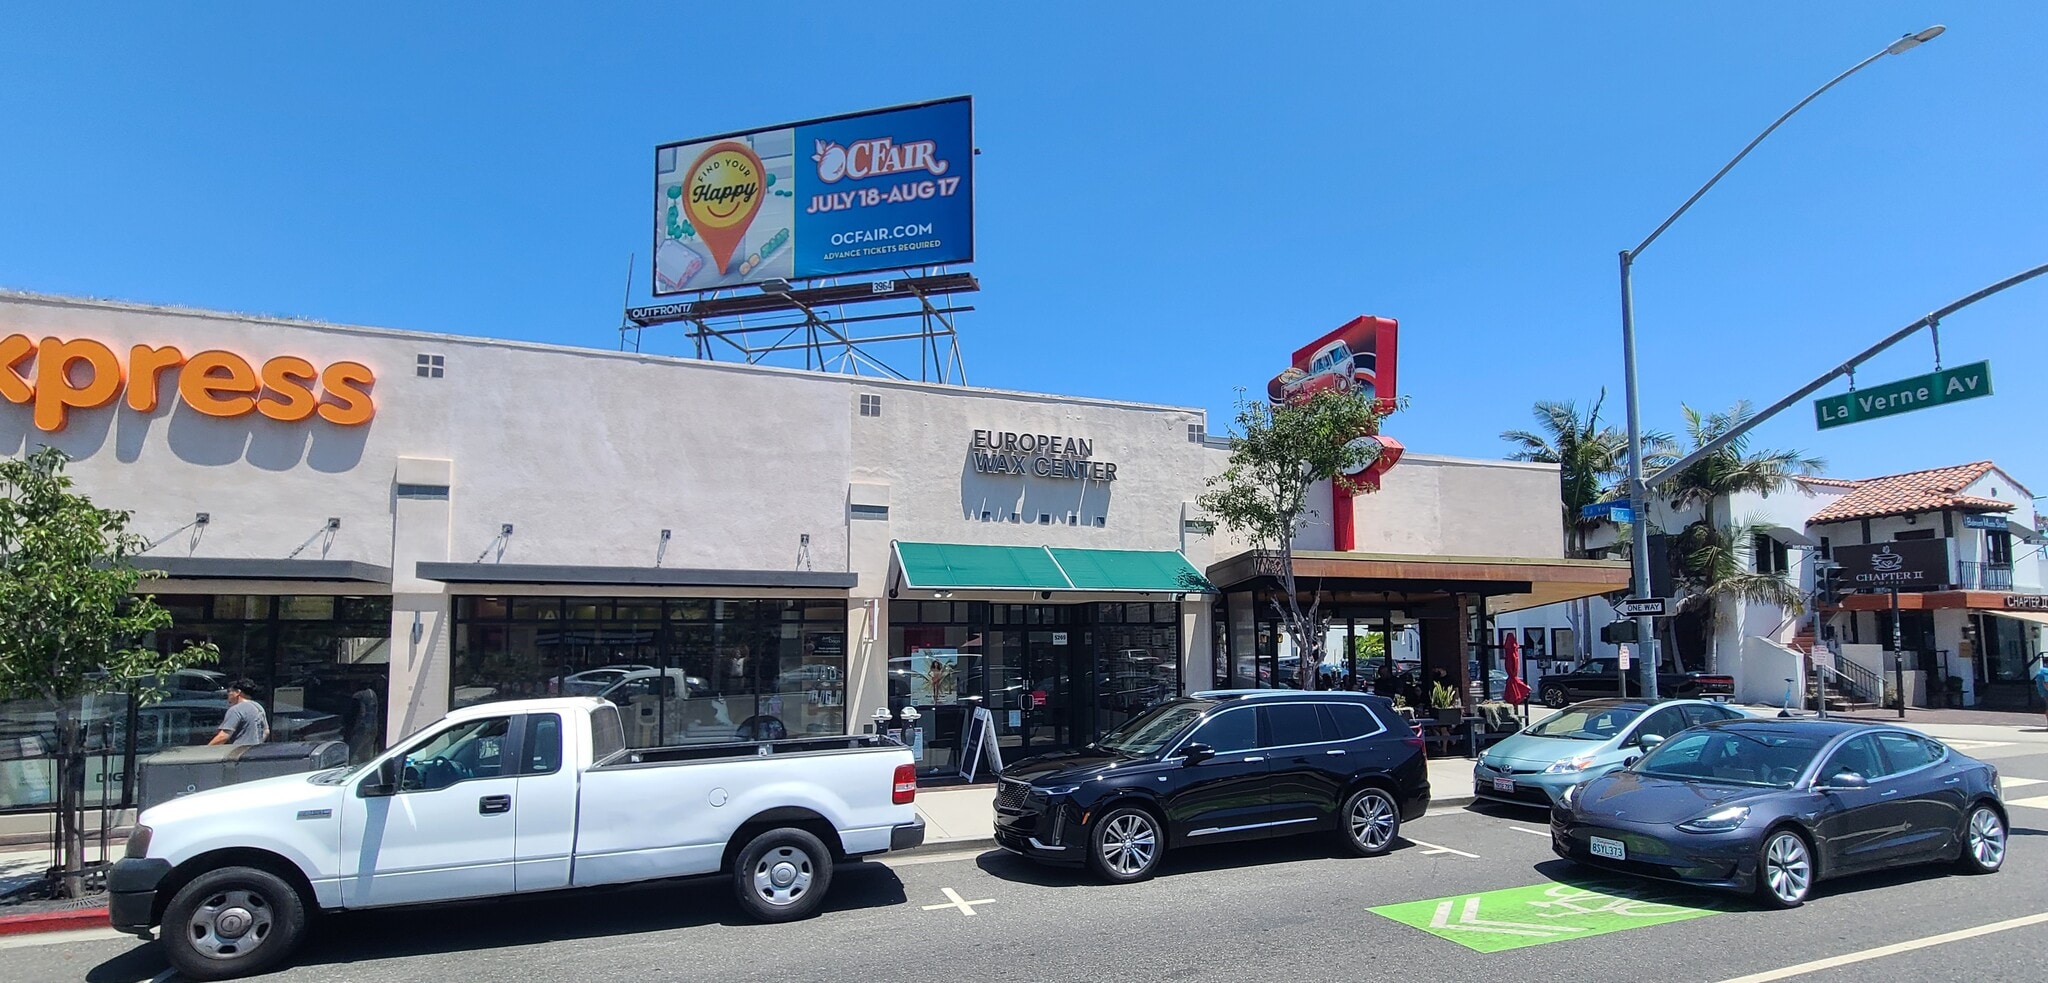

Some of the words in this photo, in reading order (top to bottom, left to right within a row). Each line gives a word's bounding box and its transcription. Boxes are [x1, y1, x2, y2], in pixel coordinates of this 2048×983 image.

[697, 161, 720, 182] FIND
[725, 159, 751, 177] YOUR
[692, 182, 758, 204] Happy
[807, 190, 856, 214] JULY
[858, 180, 936, 207] 18-AUG
[937, 176, 961, 196] 17
[830, 222, 933, 245] OCFAIR.COM
[823, 249, 861, 260] ADVANCE
[862, 244, 897, 256] TICKETS
[898, 239, 941, 251] REQUIRED
[873, 281, 892, 291] 3964
[1822, 405, 1849, 422] La
[1859, 387, 1929, 413] Verne
[1945, 375, 1979, 395] Av
[973, 429, 1093, 457] EUROPEAN
[974, 452, 1027, 475] WAX
[1033, 457, 1118, 481] CENTER
[1856, 571, 1911, 582] CHAPTER
[1912, 570, 1924, 579] II
[2007, 595, 2040, 608] CHAPTER
